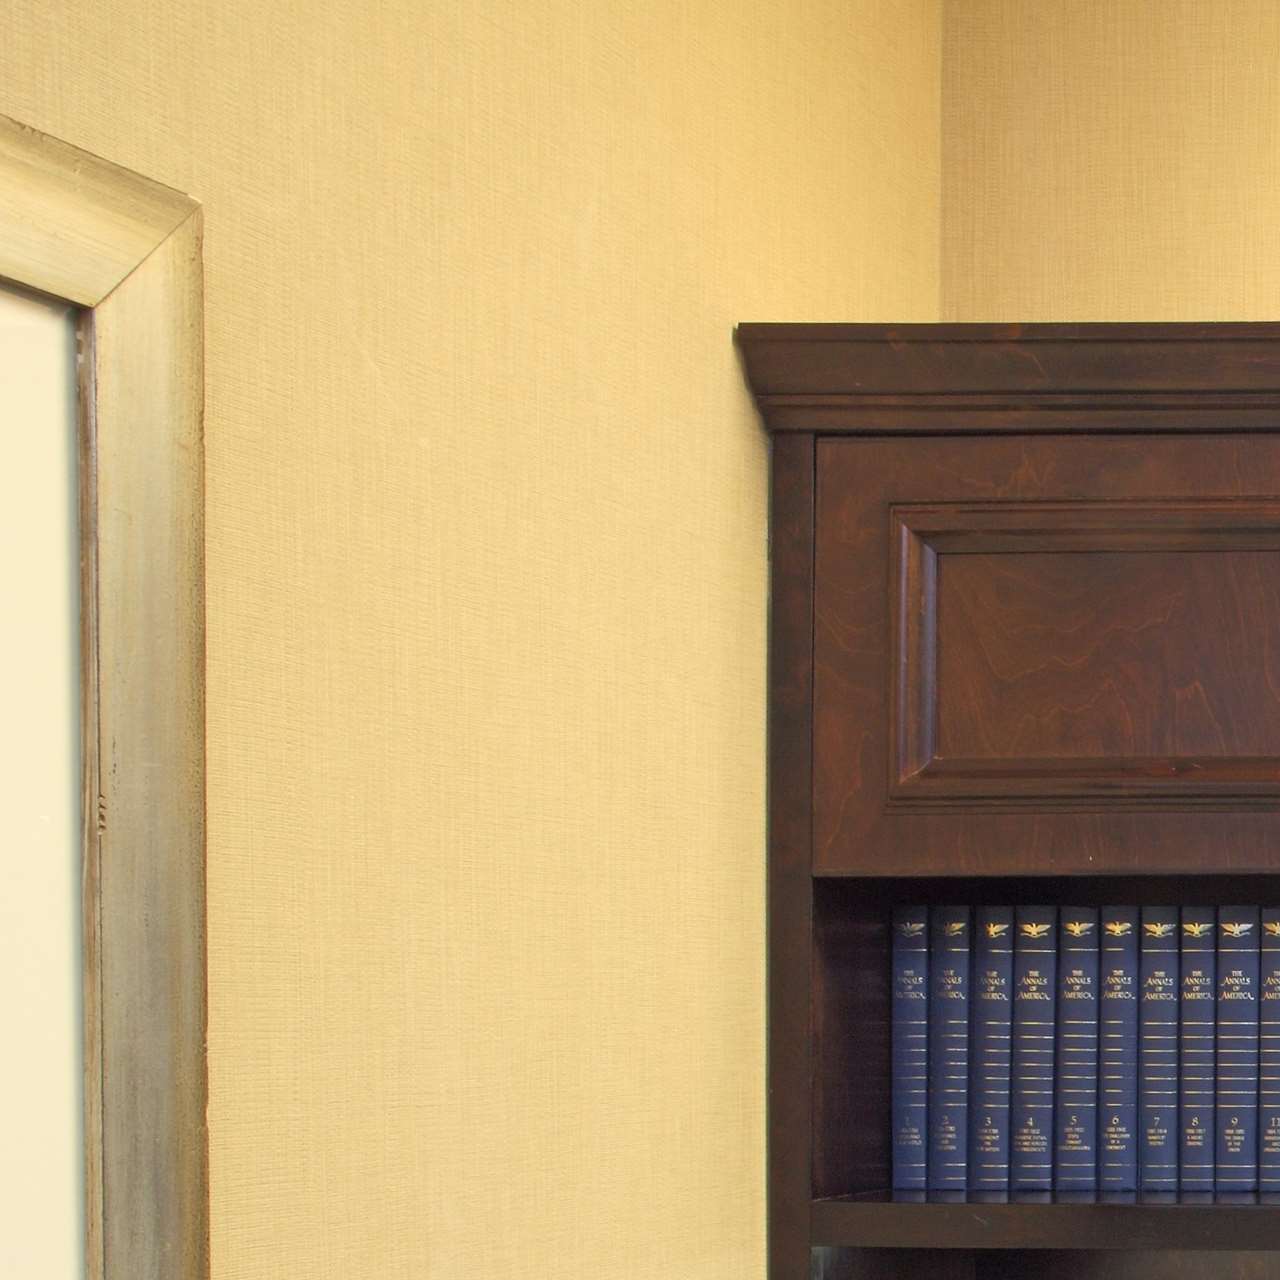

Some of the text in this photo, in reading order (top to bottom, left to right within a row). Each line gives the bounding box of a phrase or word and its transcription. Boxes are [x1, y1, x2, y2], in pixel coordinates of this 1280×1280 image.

[985, 1117, 992, 1126] 3
[1027, 1117, 1034, 1126] 4
[1071, 1116, 1078, 1125] 5
[1112, 1115, 1120, 1125] 6
[1153, 1117, 1161, 1126] 7
[1191, 1117, 1199, 1126] 8
[1231, 1117, 1238, 1127] 9
[1271, 1117, 1280, 1127] 11
